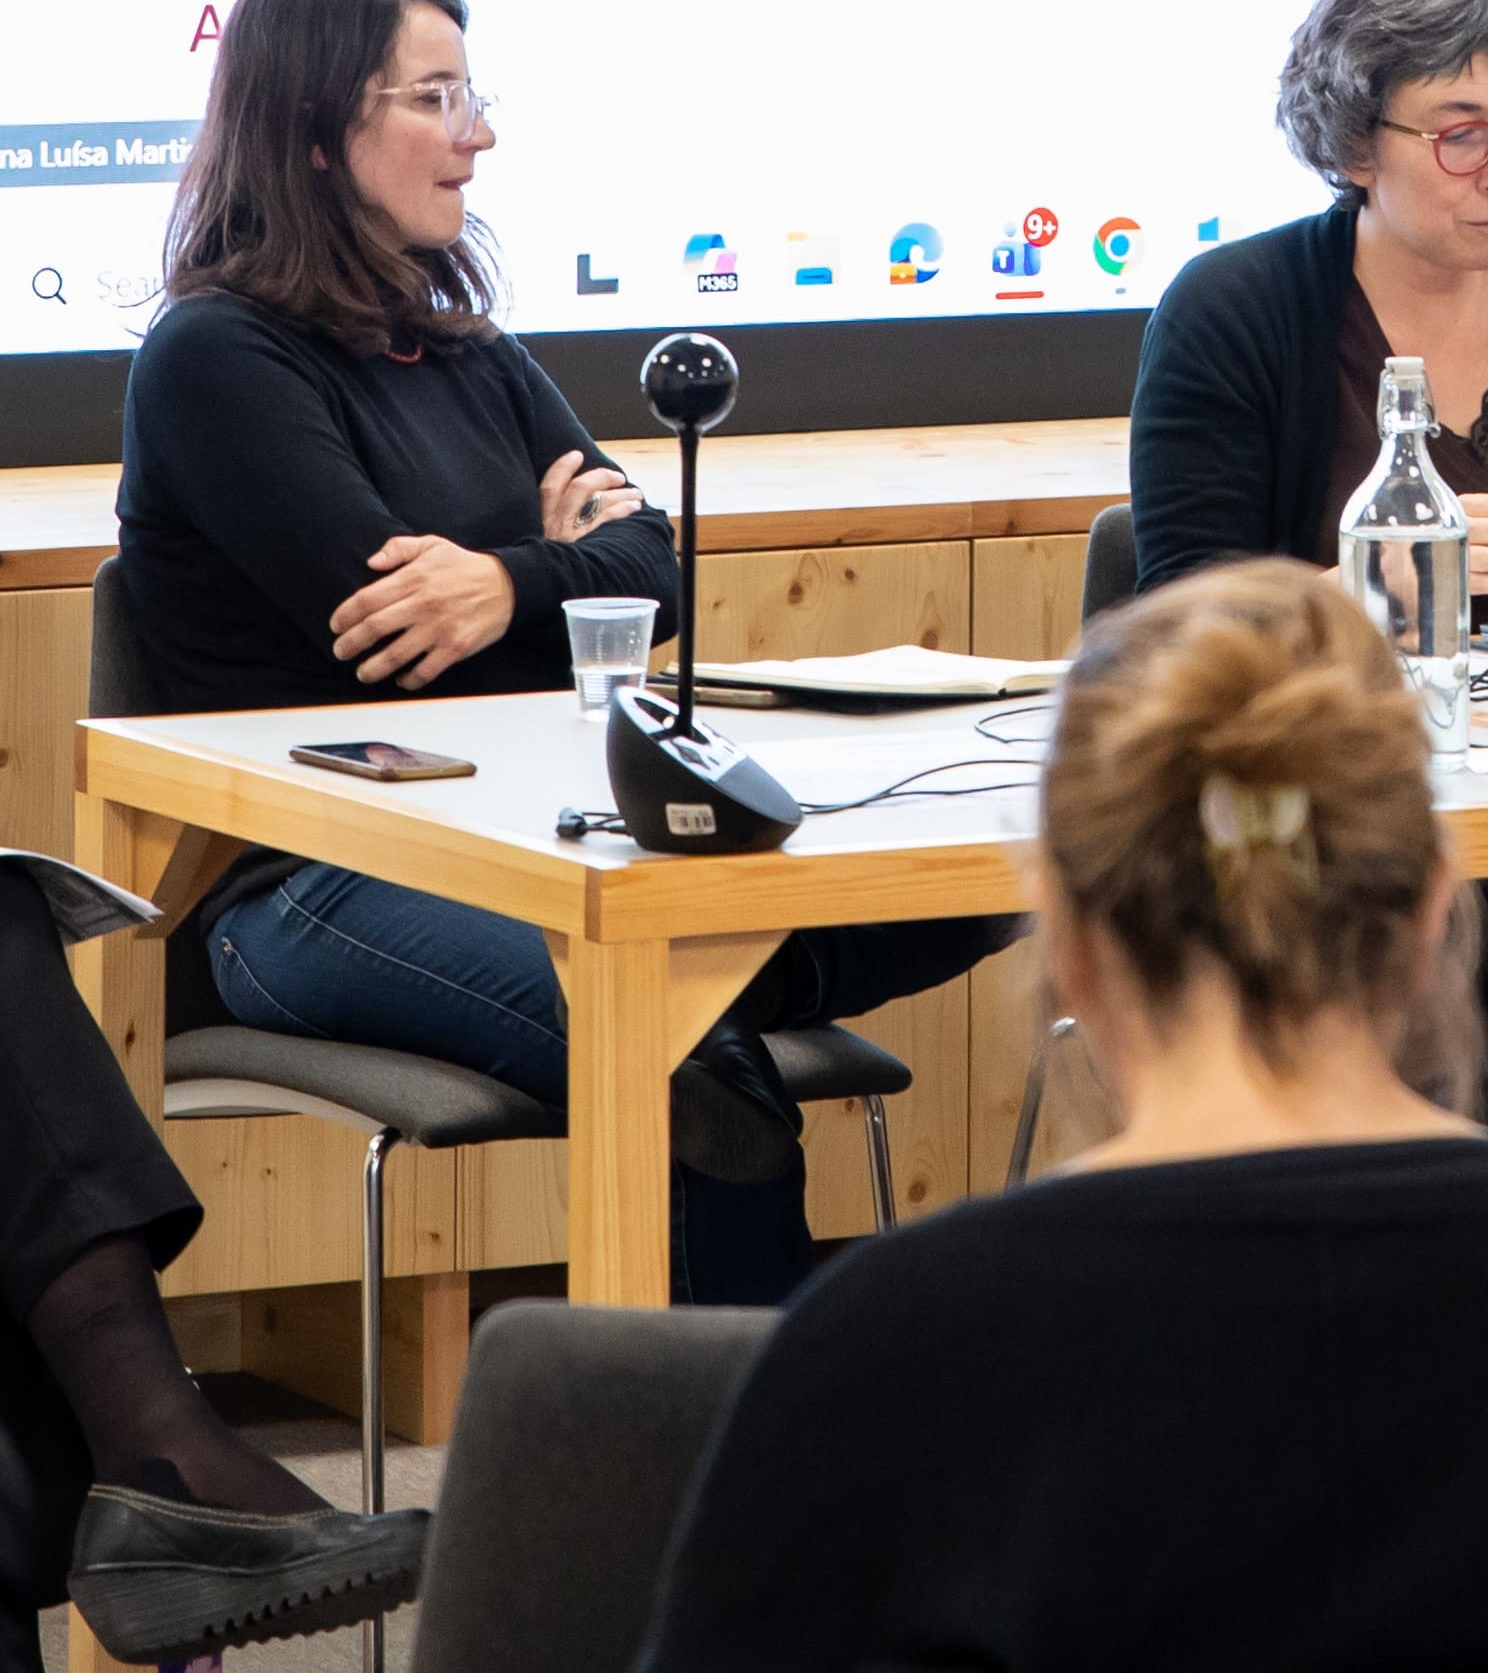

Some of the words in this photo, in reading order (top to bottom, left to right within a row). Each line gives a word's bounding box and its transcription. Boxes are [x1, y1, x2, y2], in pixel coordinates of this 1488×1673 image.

[190, 5, 222, 52] A
[40, 140, 108, 167] Luísa
[1028, 214, 1057, 240] 9+
[97, 270, 162, 300] Sear
[699, 274, 737, 291] M365
